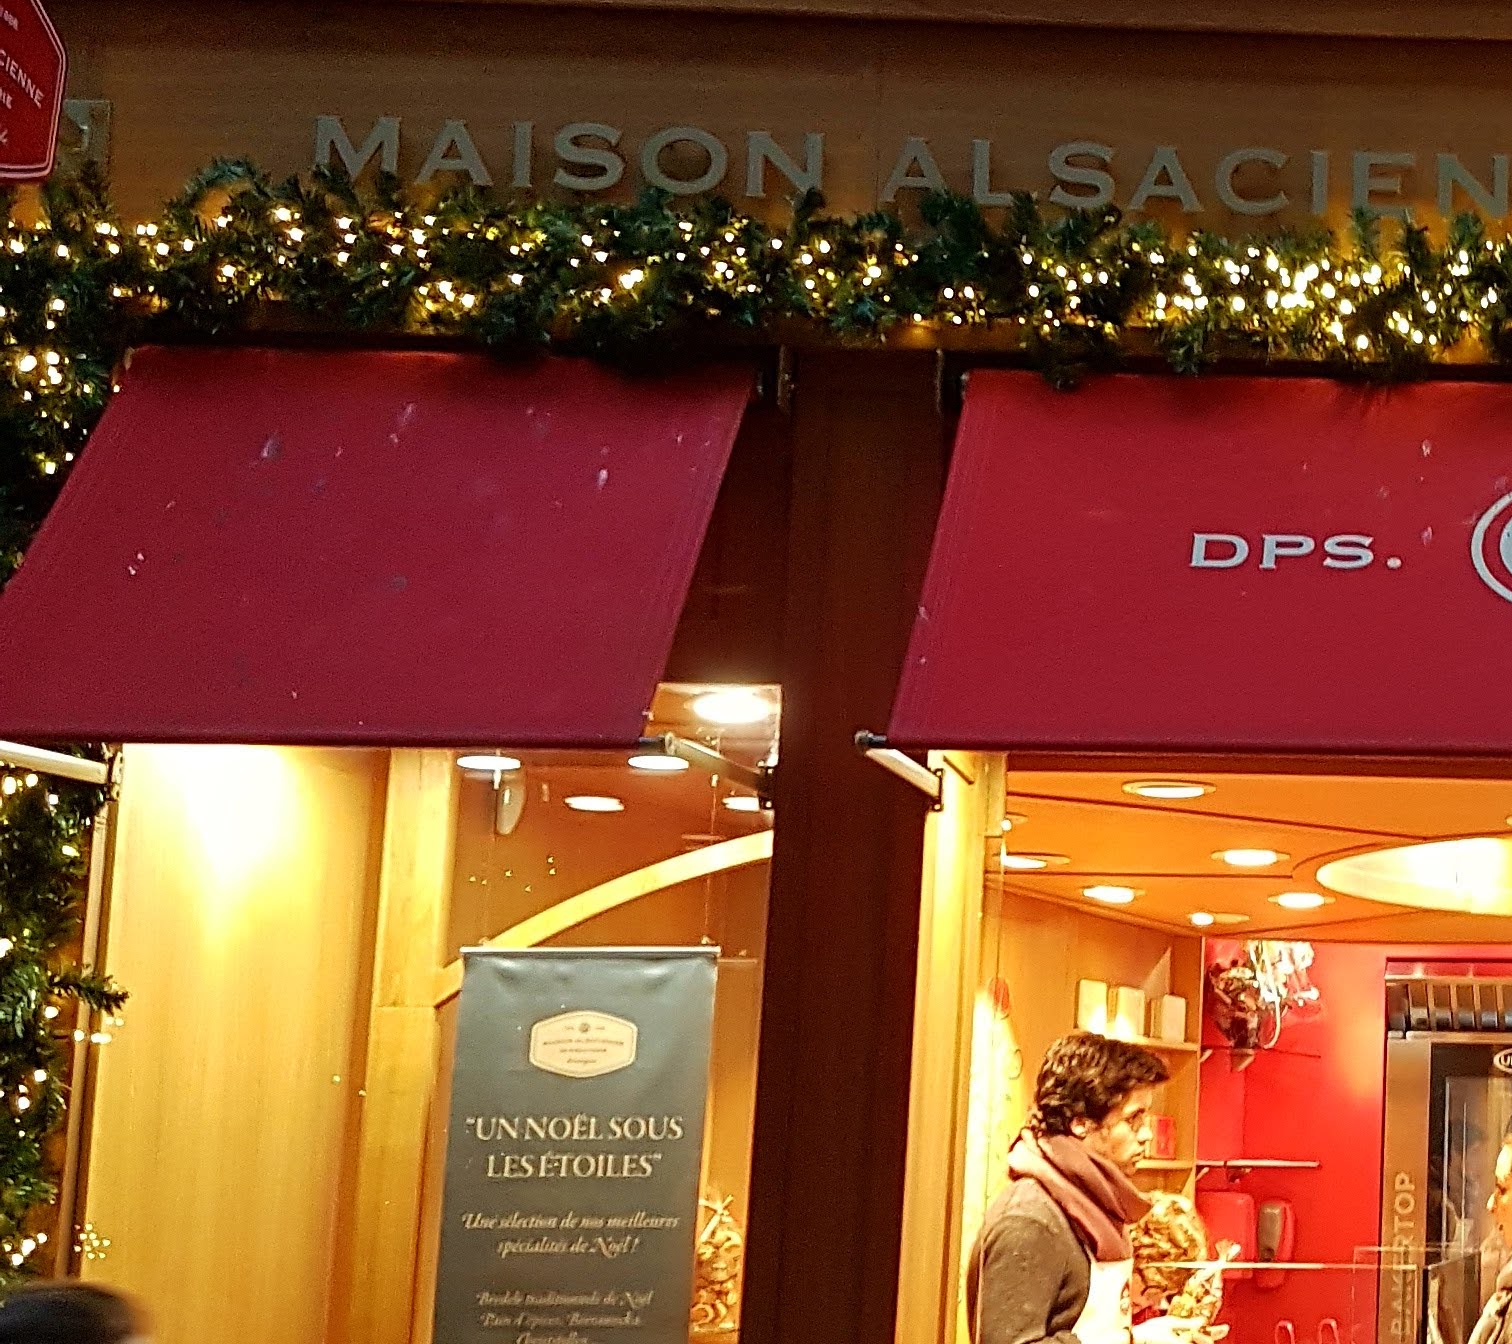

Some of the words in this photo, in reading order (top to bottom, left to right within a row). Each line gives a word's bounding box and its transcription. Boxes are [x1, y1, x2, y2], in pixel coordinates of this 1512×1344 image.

[315, 115, 824, 197] MAISON
[1189, 532, 1402, 570] DPS.
[523, 1112, 604, 1141] NOËL
[608, 1115, 684, 1141] SOUS
[487, 1153, 533, 1178] LES
[559, 1210, 579, 1230] de
[606, 1210, 682, 1230] meilleures
[569, 1235, 589, 1254] de
